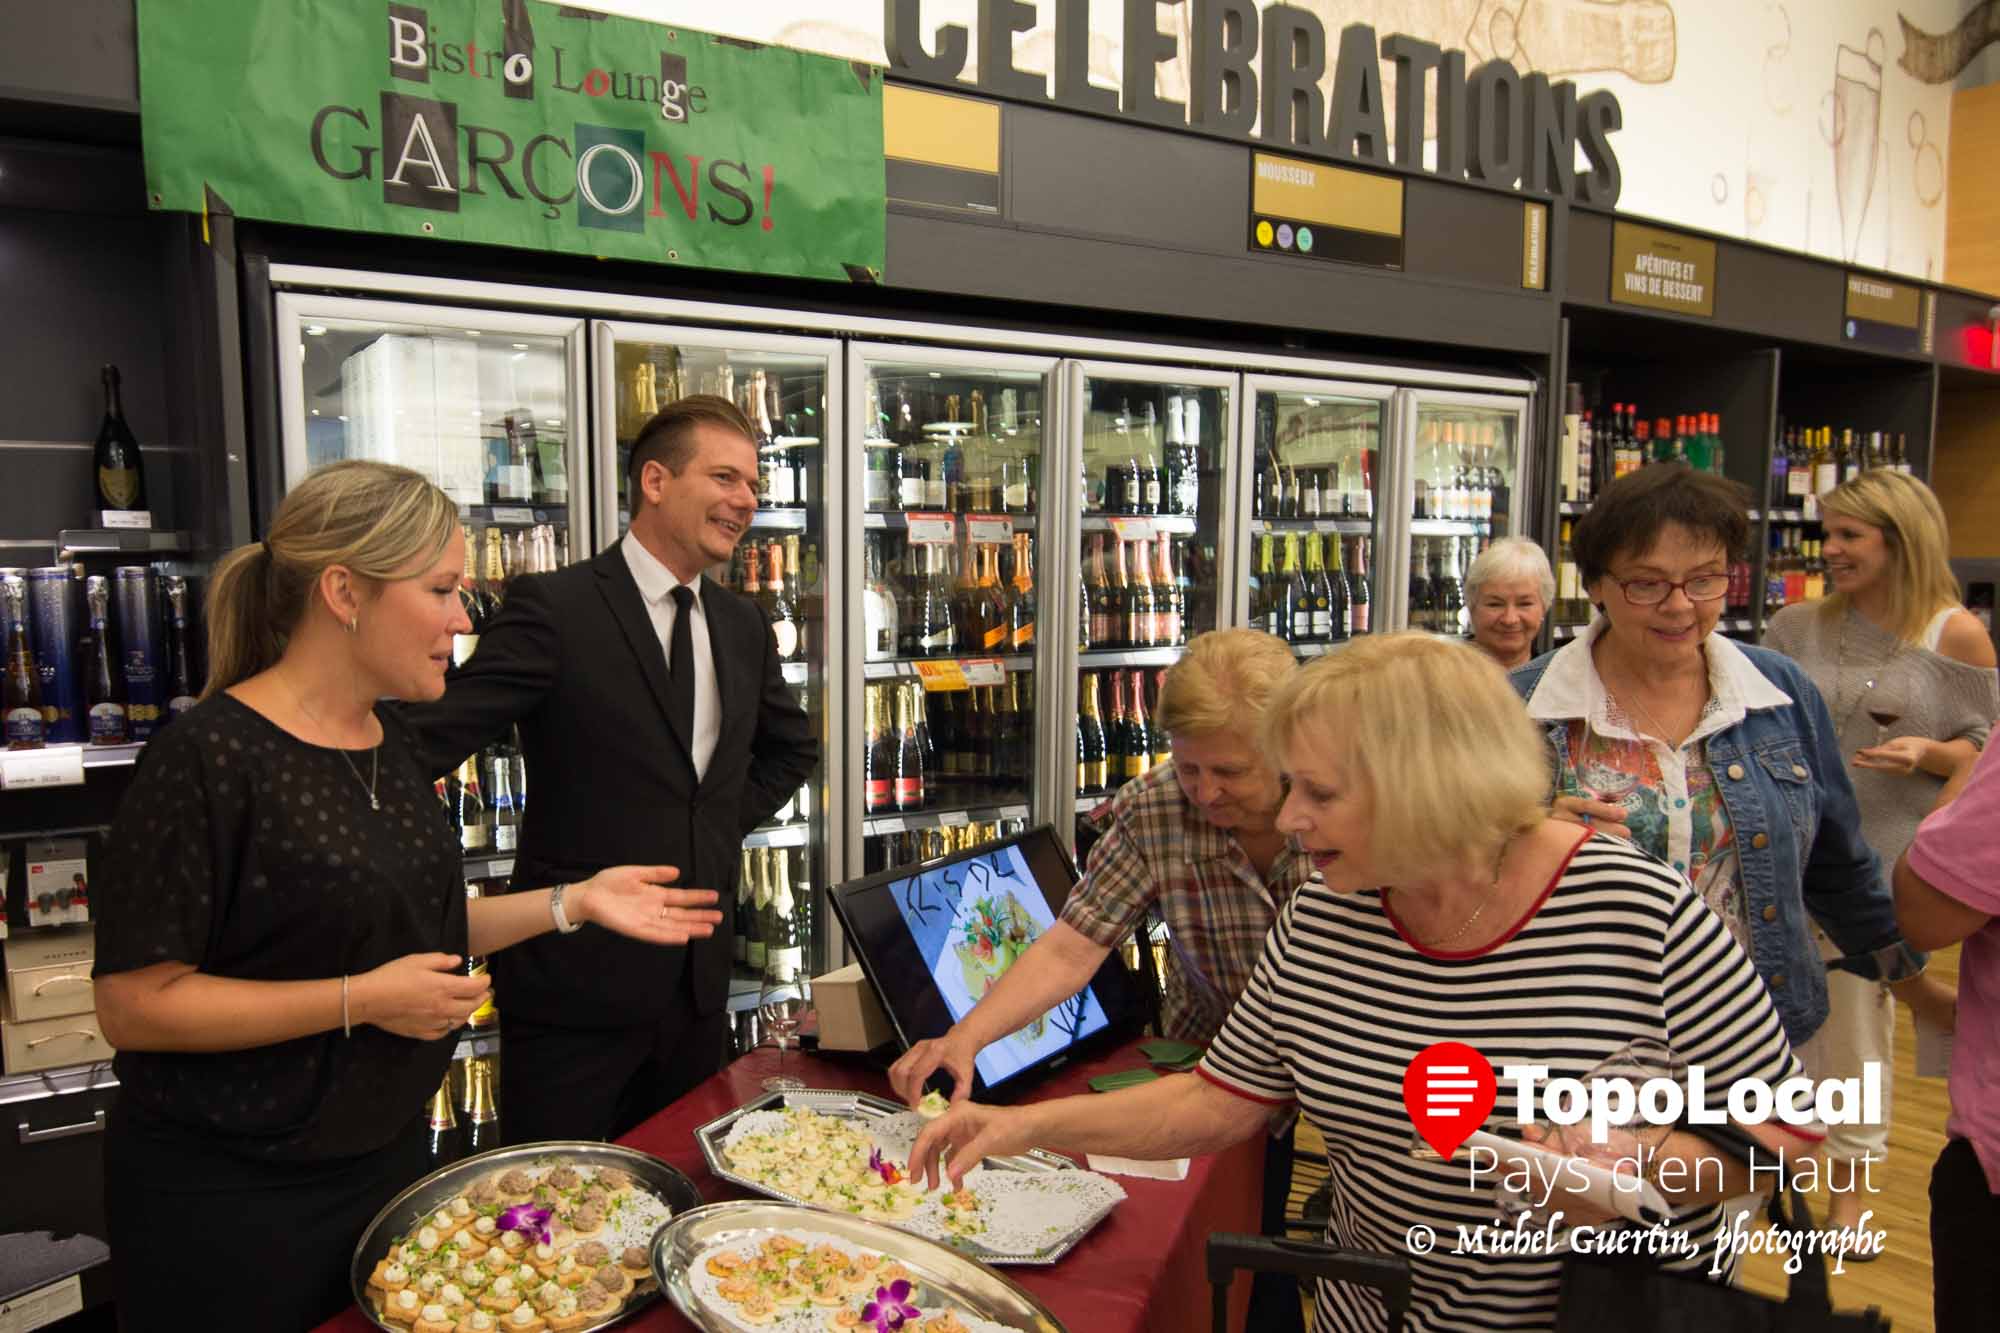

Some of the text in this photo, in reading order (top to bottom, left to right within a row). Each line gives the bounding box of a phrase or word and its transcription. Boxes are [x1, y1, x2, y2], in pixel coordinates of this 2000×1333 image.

[389, 16, 707, 121] Bistro Lounge
[310, 106, 775, 232] GARÇONS!
[1257, 162, 1315, 188] MOUSSEUX
[1683, 262, 1696, 281] ET
[1624, 272, 1704, 304] VINS DE DESSERT
